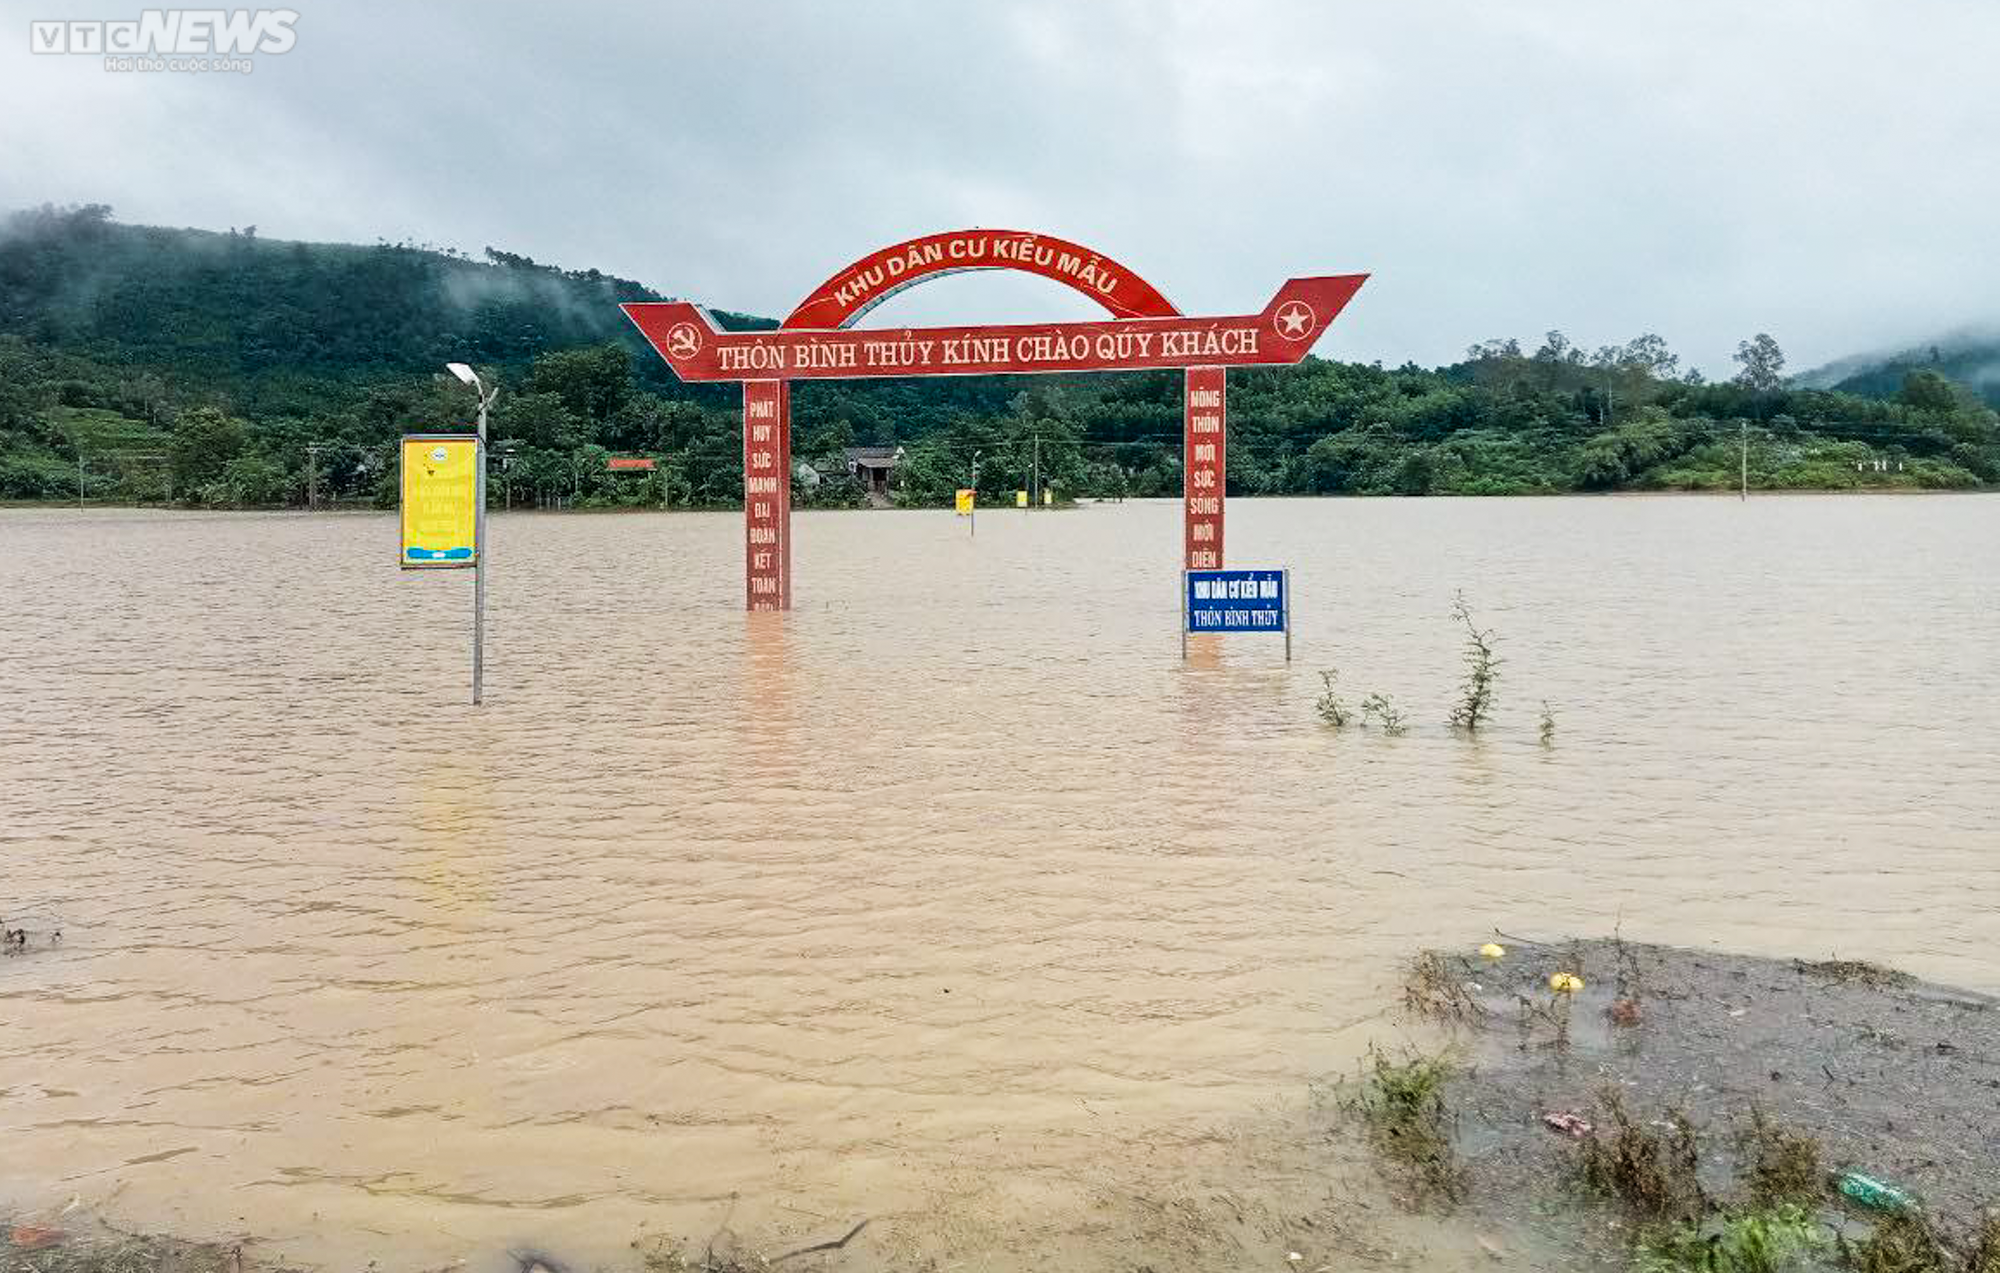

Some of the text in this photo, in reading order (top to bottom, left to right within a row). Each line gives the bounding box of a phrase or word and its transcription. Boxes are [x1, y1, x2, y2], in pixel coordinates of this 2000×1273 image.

[834, 234, 1118, 307] KHU DÂN CƯ KIỂU MẪU
[717, 339, 785, 370] THÔN
[793, 338, 857, 368] BÌNH
[864, 330, 935, 366] THỦY
[941, 333, 1011, 365] KÍNH
[1016, 328, 1090, 362] CHÀO
[1161, 323, 1259, 357] KHÁCH
[1190, 386, 1220, 407] NÔNG
[1192, 411, 1219, 432] THÔN
[753, 425, 771, 442] HUY
[1193, 464, 1214, 488] SỨC
[1194, 605, 1222, 626] THÔN
